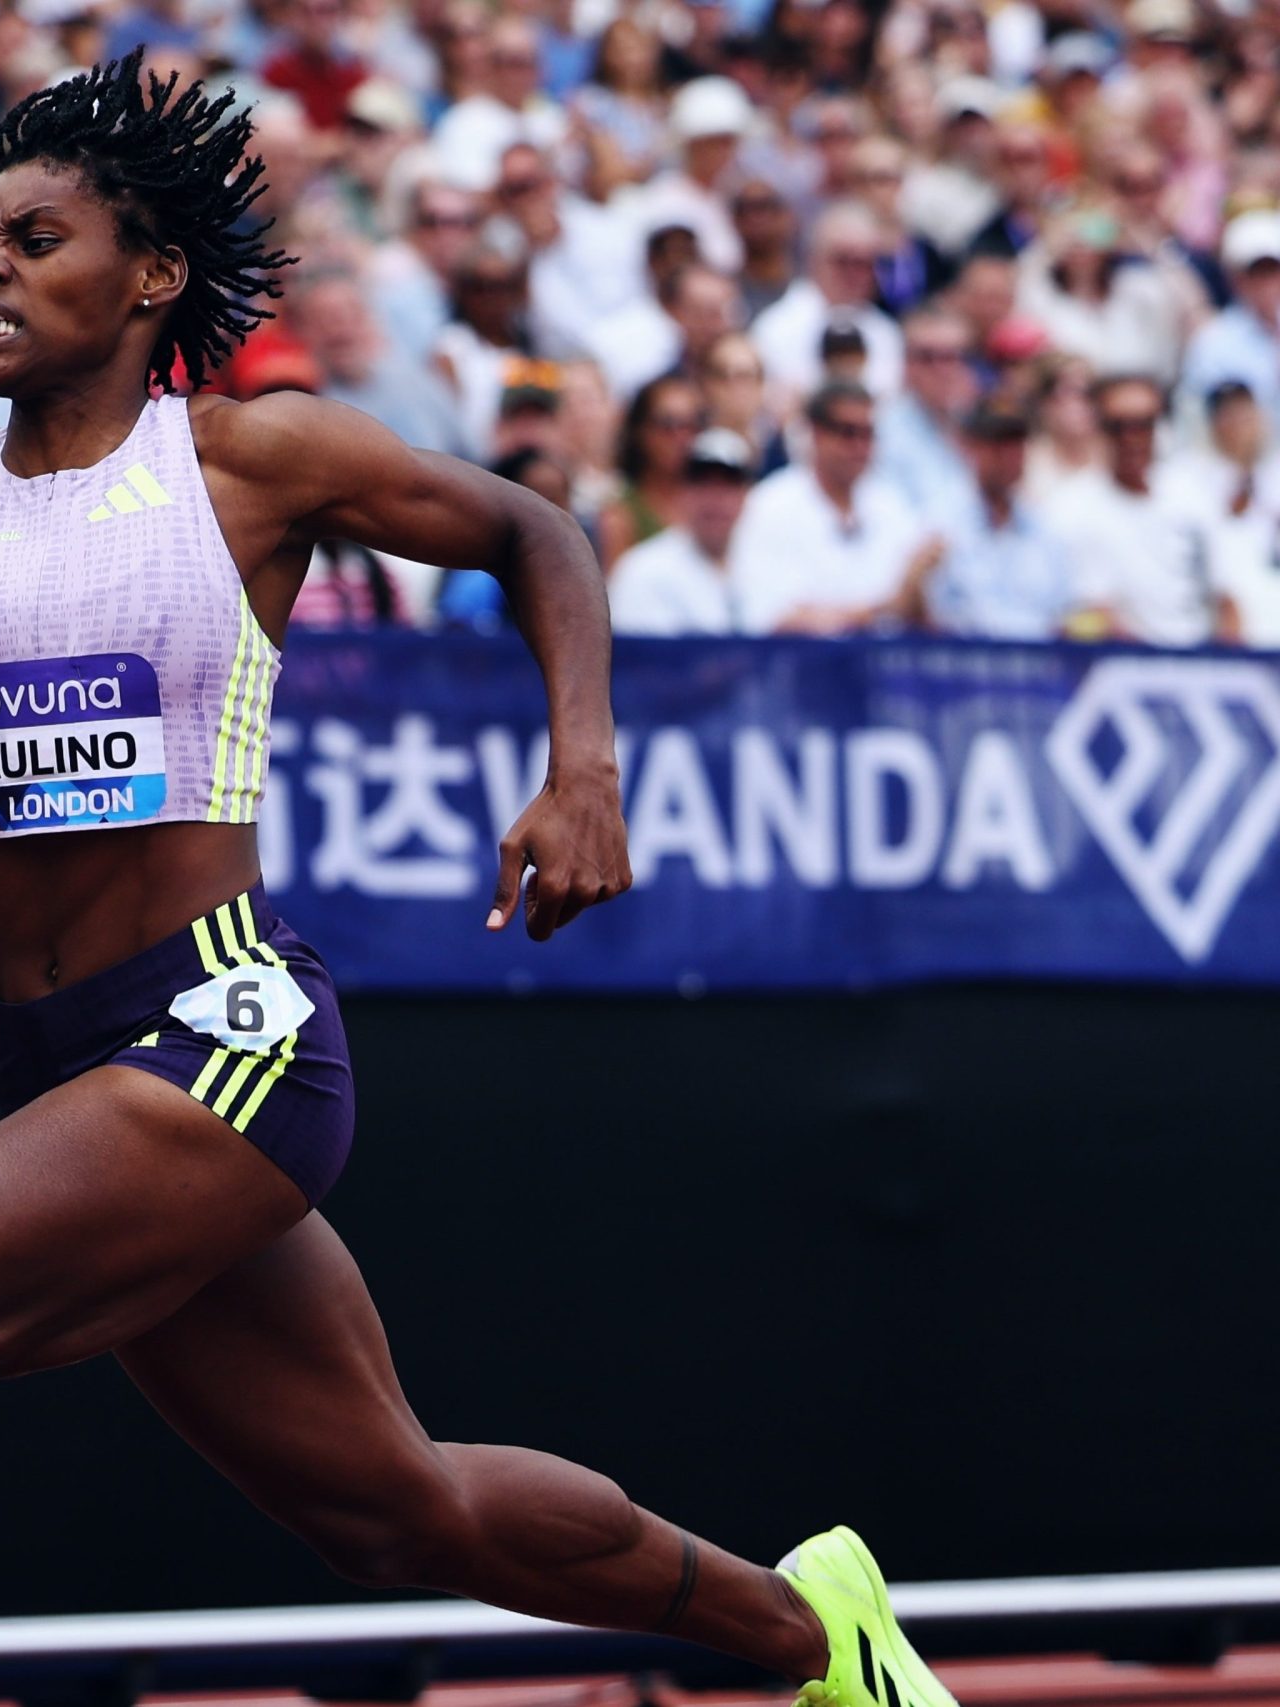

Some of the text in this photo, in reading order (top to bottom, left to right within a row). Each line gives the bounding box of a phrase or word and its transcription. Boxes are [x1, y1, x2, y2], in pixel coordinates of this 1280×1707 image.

[9, 787, 134, 821] LONDON
[261, 714, 479, 899] 达
[226, 981, 265, 1033] 6
